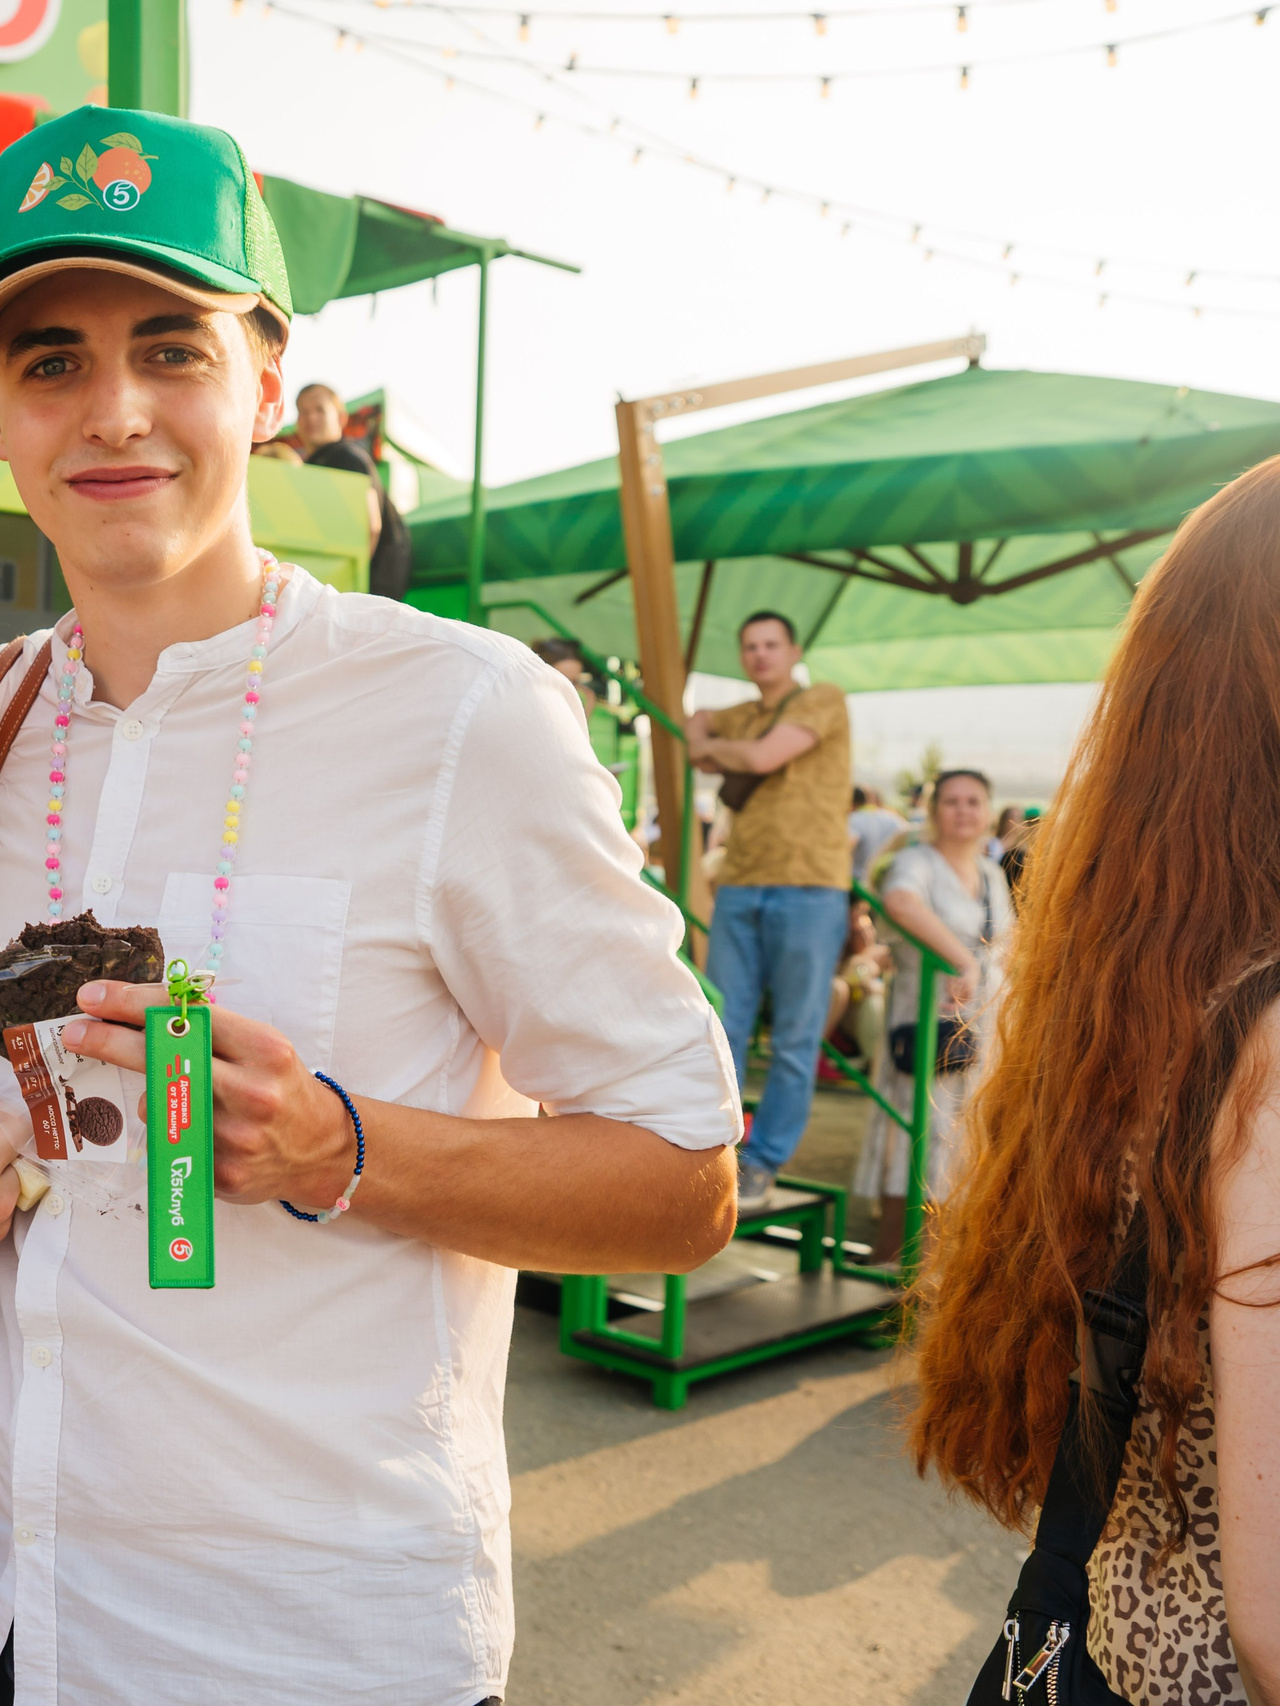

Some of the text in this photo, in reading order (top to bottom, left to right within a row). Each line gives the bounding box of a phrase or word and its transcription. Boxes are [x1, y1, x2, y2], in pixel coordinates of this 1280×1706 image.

[113, 182, 131, 205] 5
[169, 1086, 178, 1140] от 30 минут
[180, 1080, 189, 1124] Доставка
[43, 1120, 51, 1130] 60
[47, 1104, 60, 1151] масса нетто:
